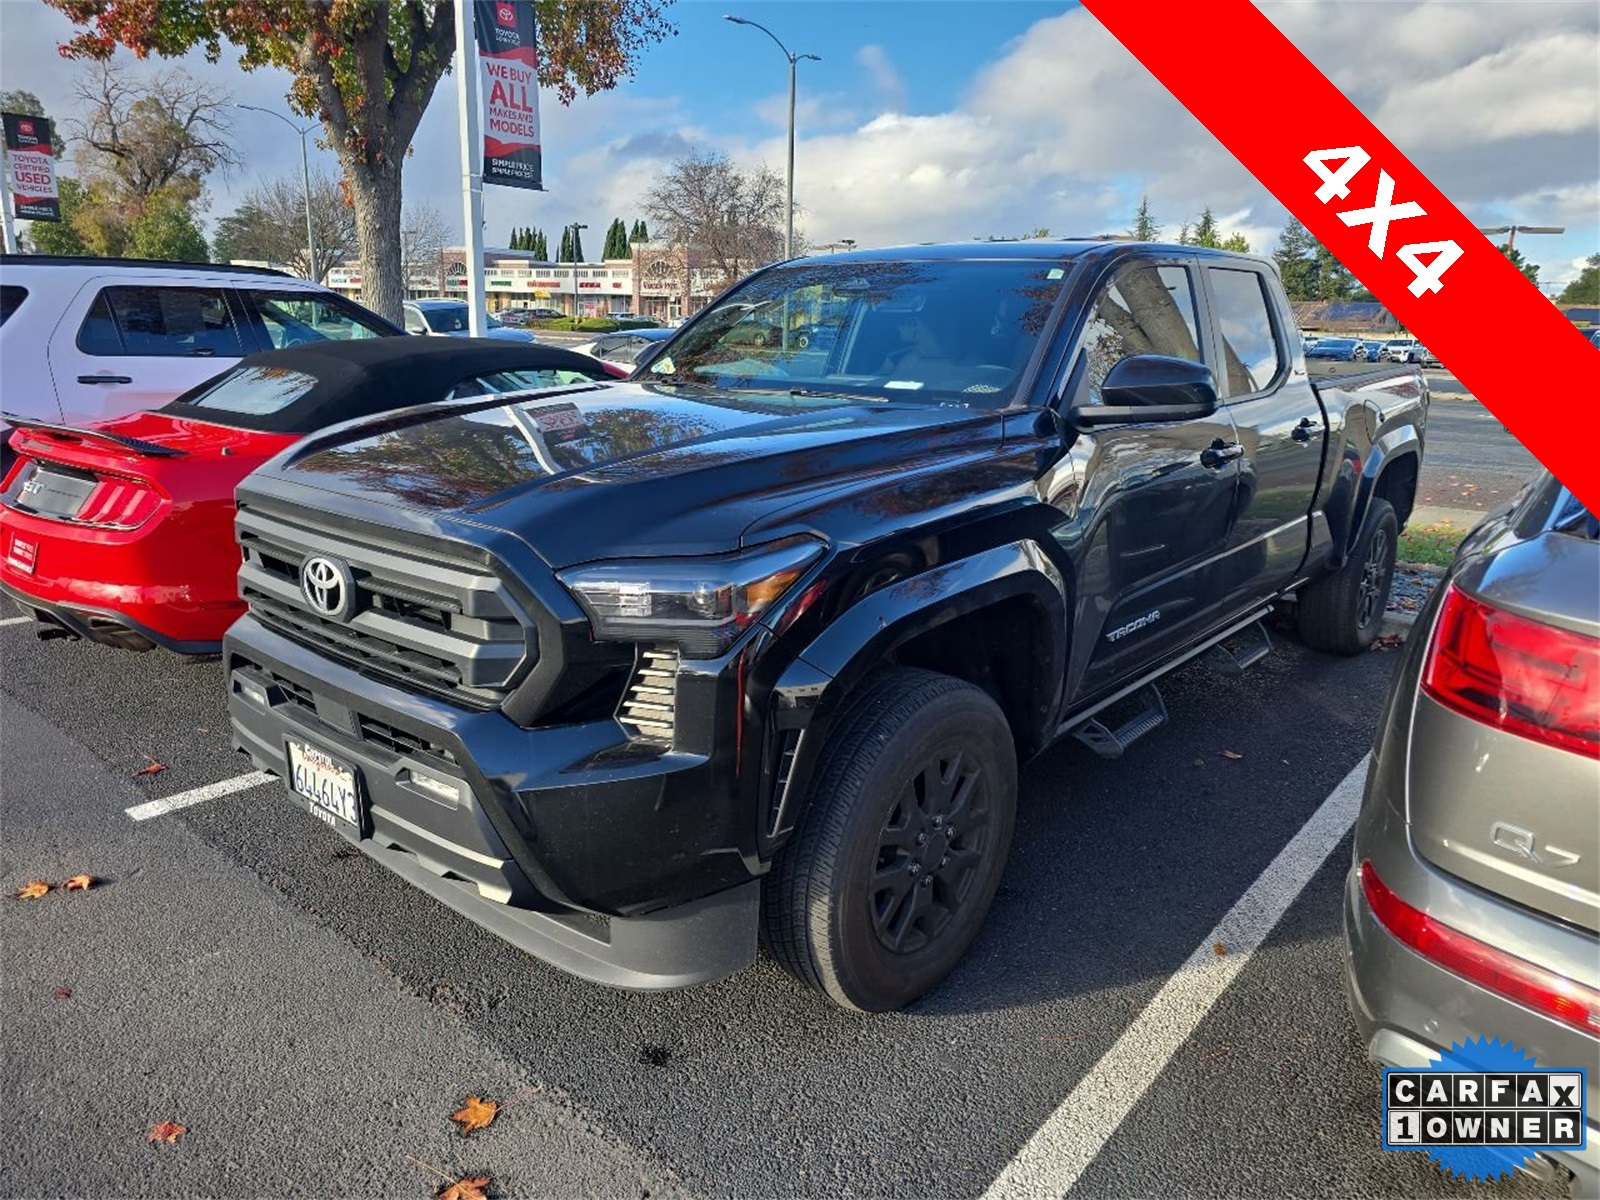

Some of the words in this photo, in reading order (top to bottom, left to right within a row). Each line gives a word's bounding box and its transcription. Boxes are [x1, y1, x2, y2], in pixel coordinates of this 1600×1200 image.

[486, 62, 508, 79] WE
[510, 68, 532, 84] BUY
[489, 80, 533, 113] ALL
[489, 107, 517, 120] MAKES
[518, 113, 534, 123] AND
[490, 118, 535, 138] MODELS
[13, 154, 49, 166] TOYOTA
[13, 163, 51, 174] CERTIFIED
[15, 171, 51, 185] USED
[16, 183, 53, 194] VEHICLES
[1105, 610, 1161, 642] TACOMA
[309, 801, 336, 827] TOYOTA
[1490, 821, 1582, 868] Q7
